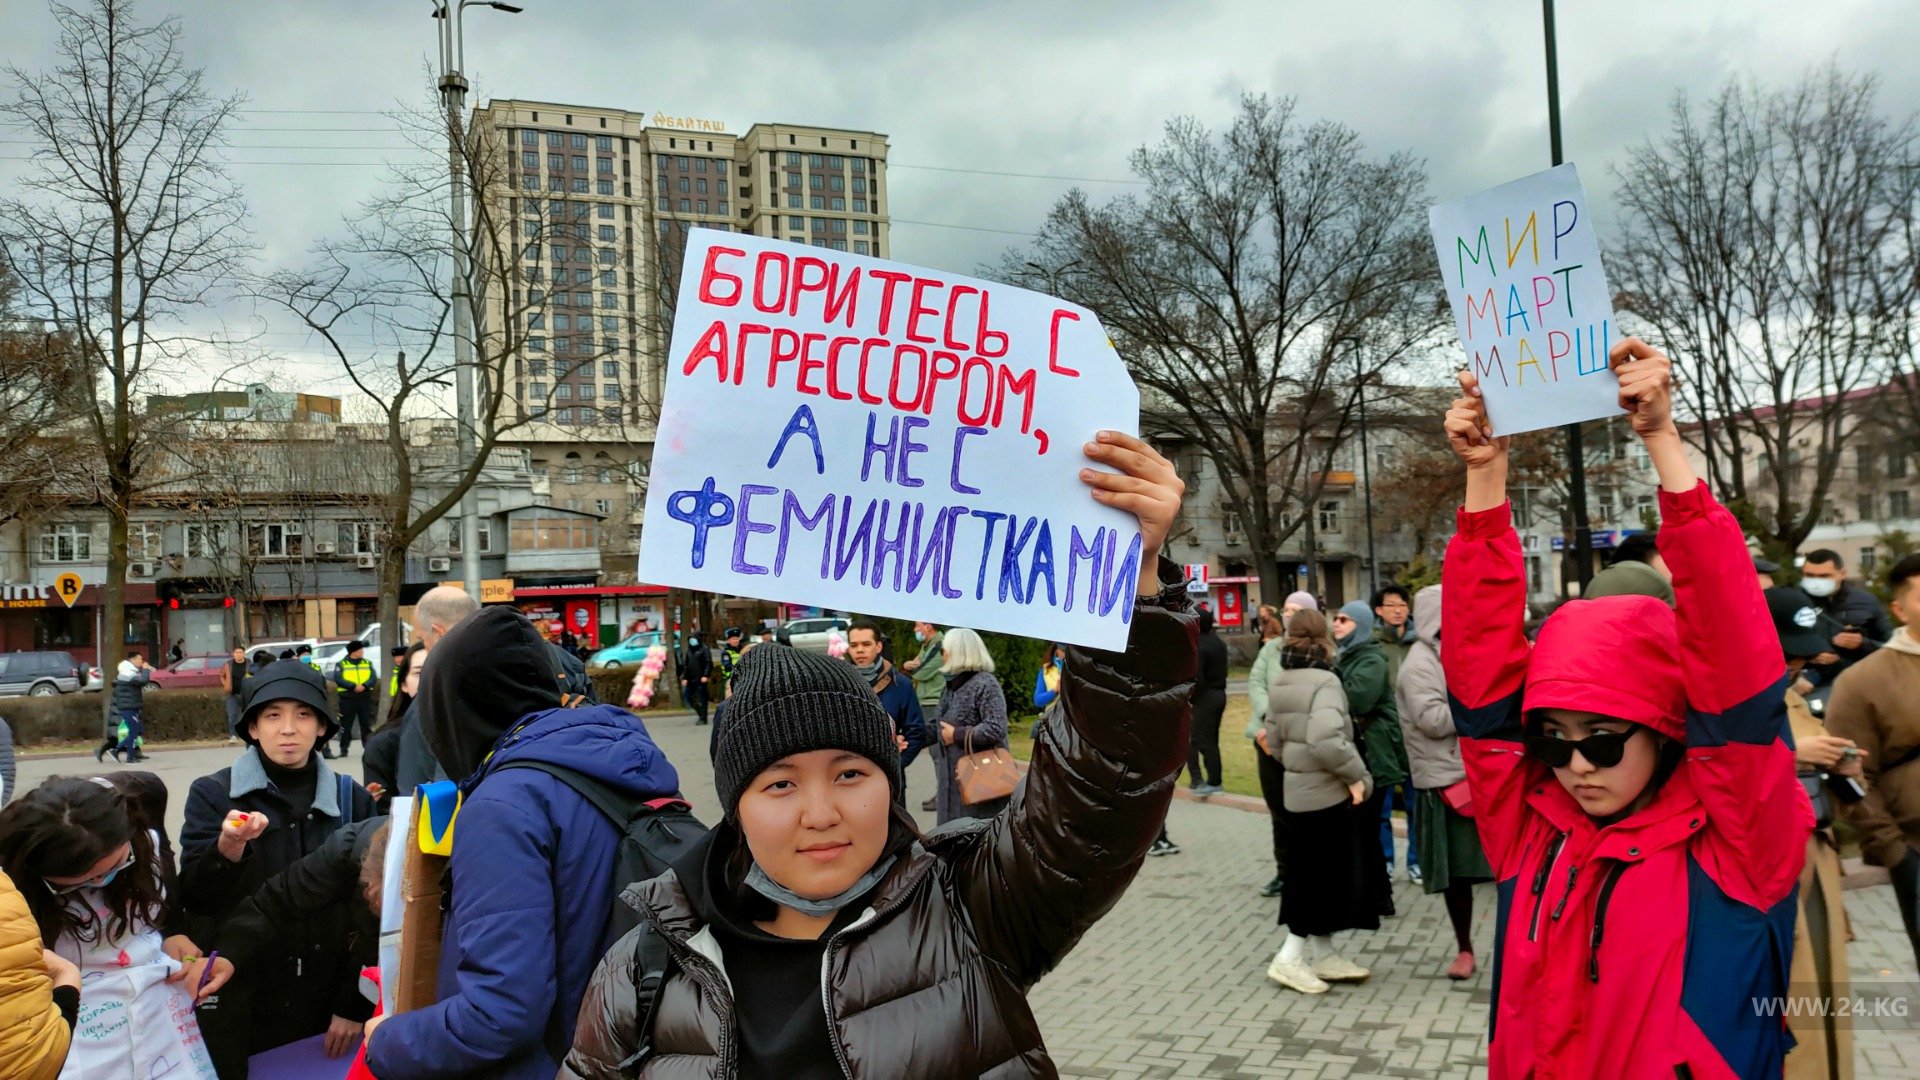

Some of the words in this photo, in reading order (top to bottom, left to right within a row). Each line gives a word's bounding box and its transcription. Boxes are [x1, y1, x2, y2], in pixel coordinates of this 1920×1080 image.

[666, 116, 725, 132] БАЙТАШ
[1457, 200, 1578, 289] МИР
[698, 245, 1009, 358] БОРИТЕСЬ
[1048, 309, 1081, 378] С
[1466, 264, 1584, 340] МАРТ
[683, 320, 1050, 456] АГРЕССОРОМ,
[1474, 319, 1610, 388] МАРШ
[767, 404, 825, 475] А
[861, 411, 930, 488] НЕ
[950, 426, 989, 495] С
[63, 578, 77, 595] B
[667, 476, 1143, 625] ФЕМИНИСТКАМИ
[9, 600, 47, 608] HOUSE
